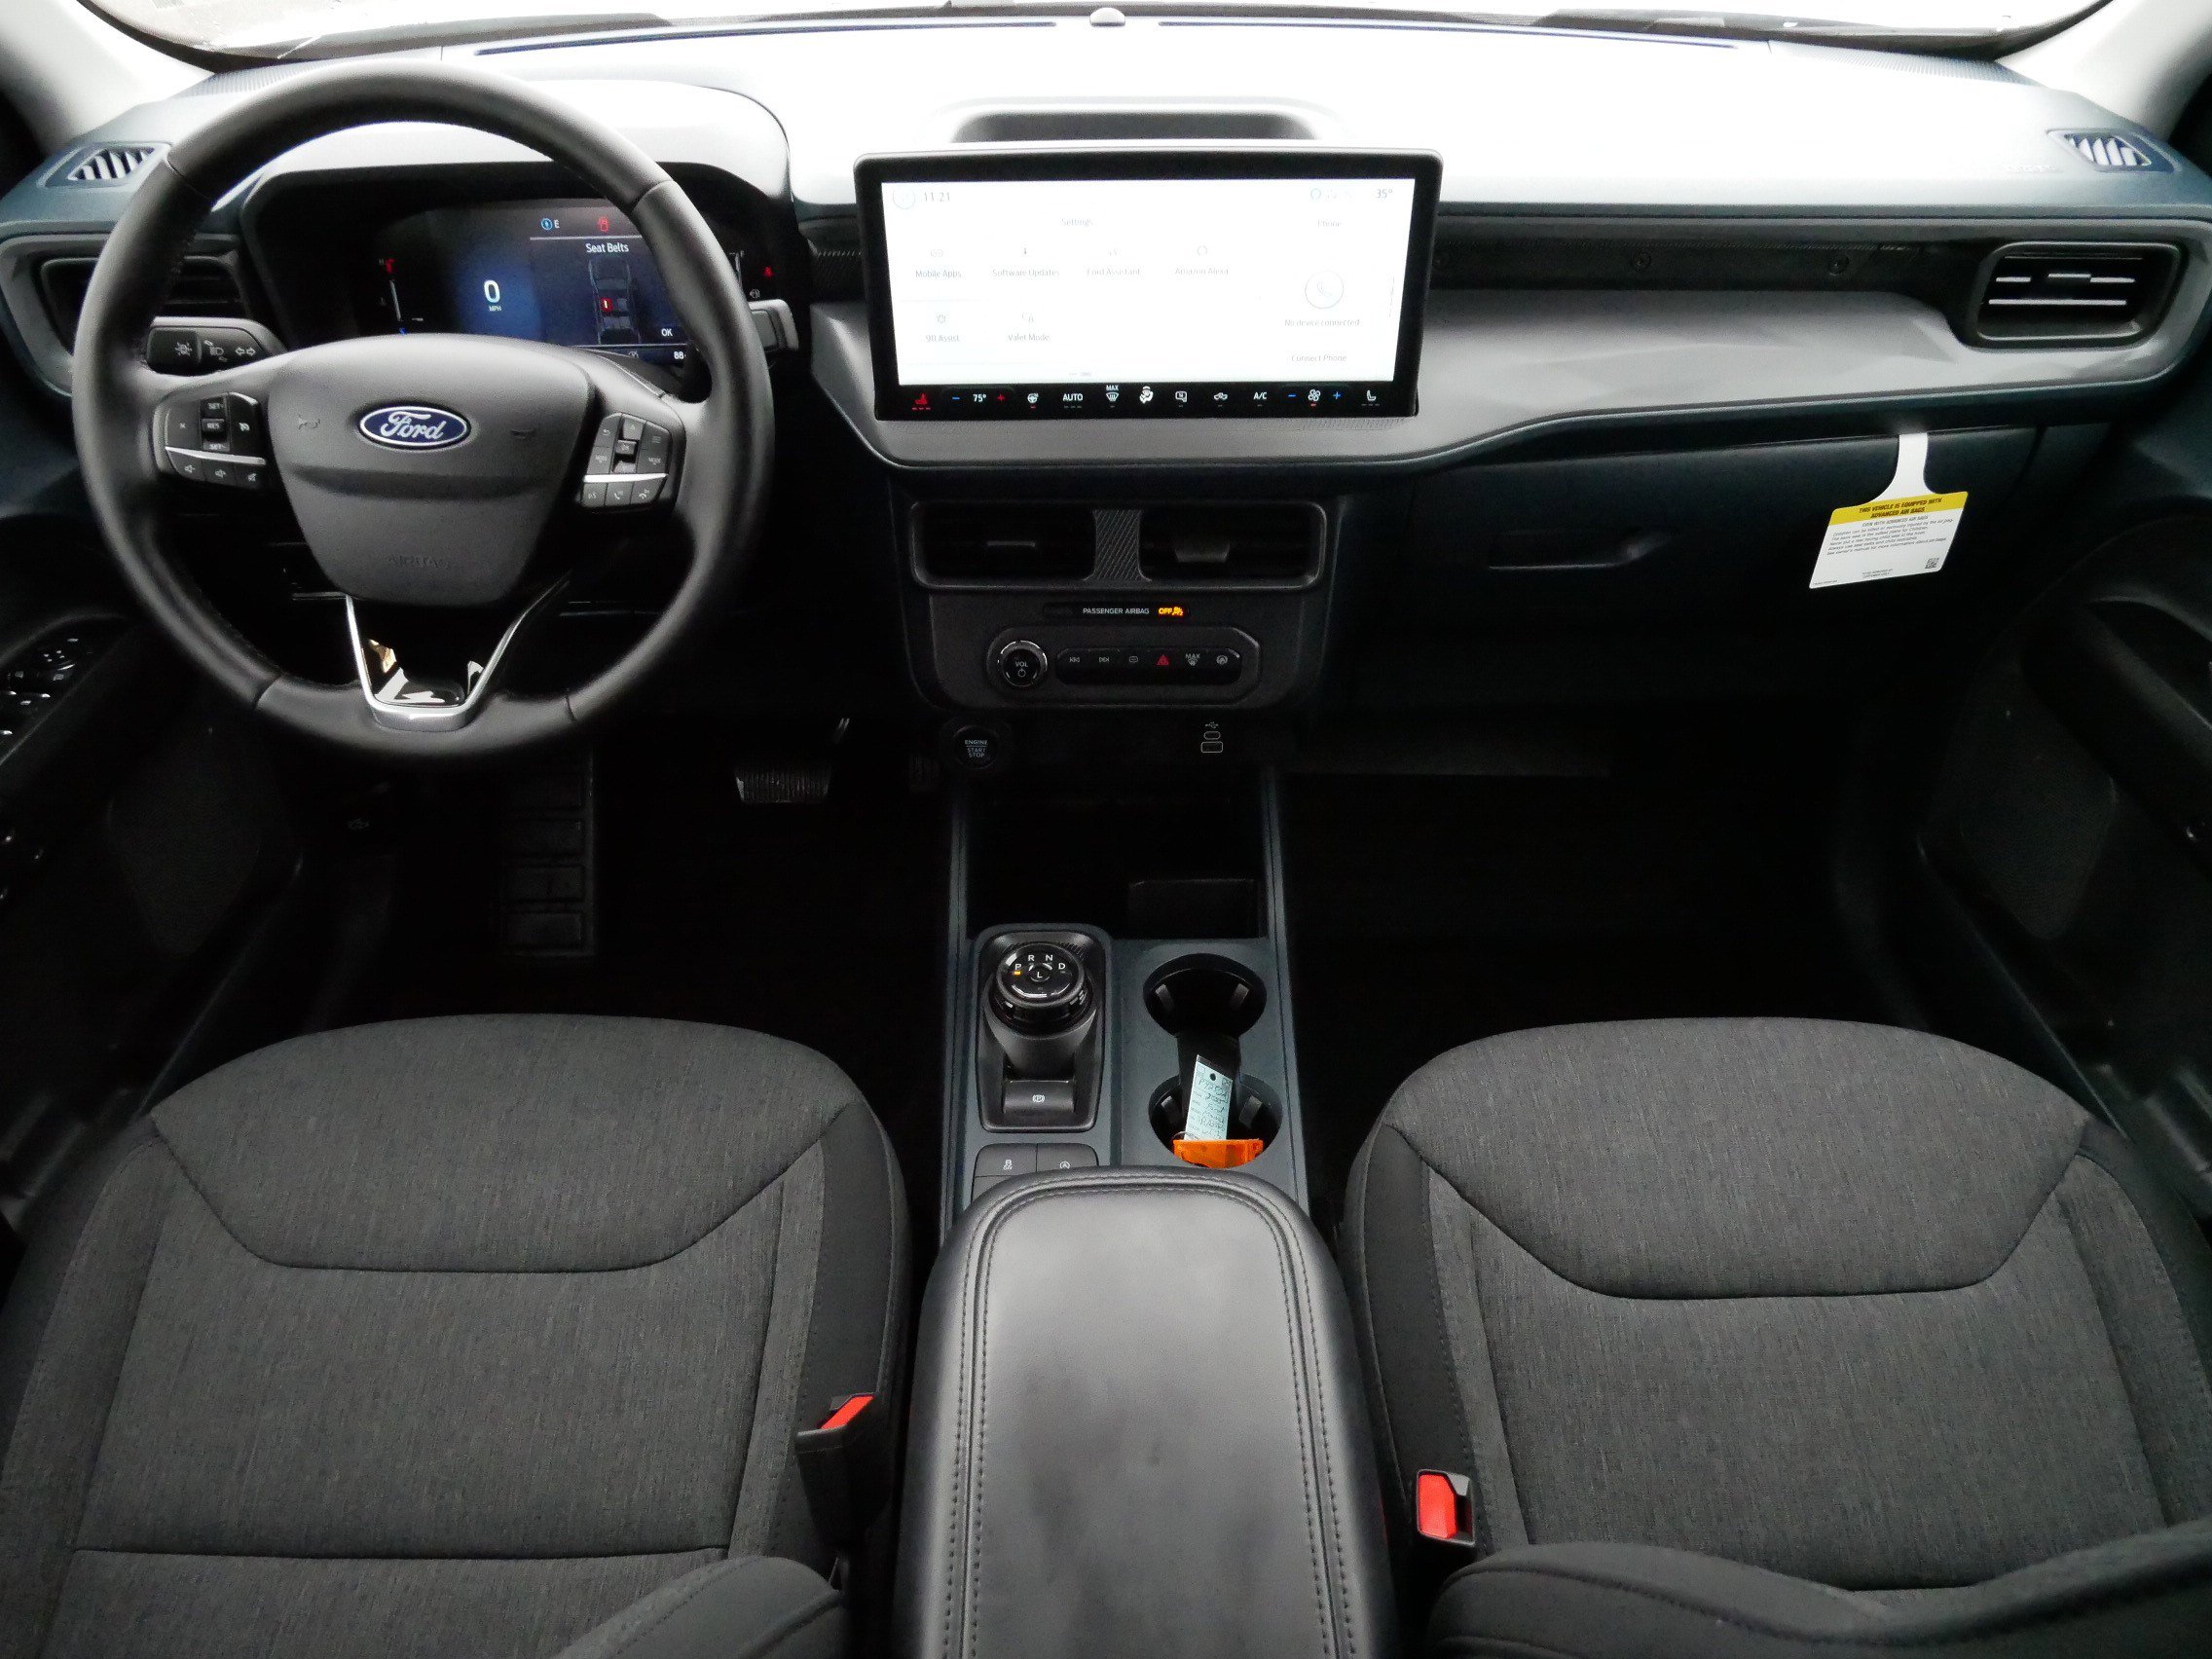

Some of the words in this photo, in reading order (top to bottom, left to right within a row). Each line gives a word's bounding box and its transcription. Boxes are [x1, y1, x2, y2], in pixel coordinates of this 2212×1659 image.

[554, 219, 560, 228] E
[585, 242, 606, 252] Seat
[607, 241, 629, 252] Belts
[915, 269, 940, 277] Mobile
[941, 269, 962, 279] Apps
[992, 268, 1027, 277] Software
[1028, 268, 1060, 278] Updates
[484, 279, 500, 303] 0
[1284, 318, 1295, 327] No
[661, 328, 673, 337] OK
[1007, 333, 1027, 343] Valet
[1028, 333, 1051, 343] Mode
[1322, 353, 1347, 363] Phone
[1062, 393, 1084, 402] AUTO
[1253, 391, 1268, 400] A/C
[380, 411, 447, 440] Ford
[1870, 510, 1899, 519] ADVANCED
